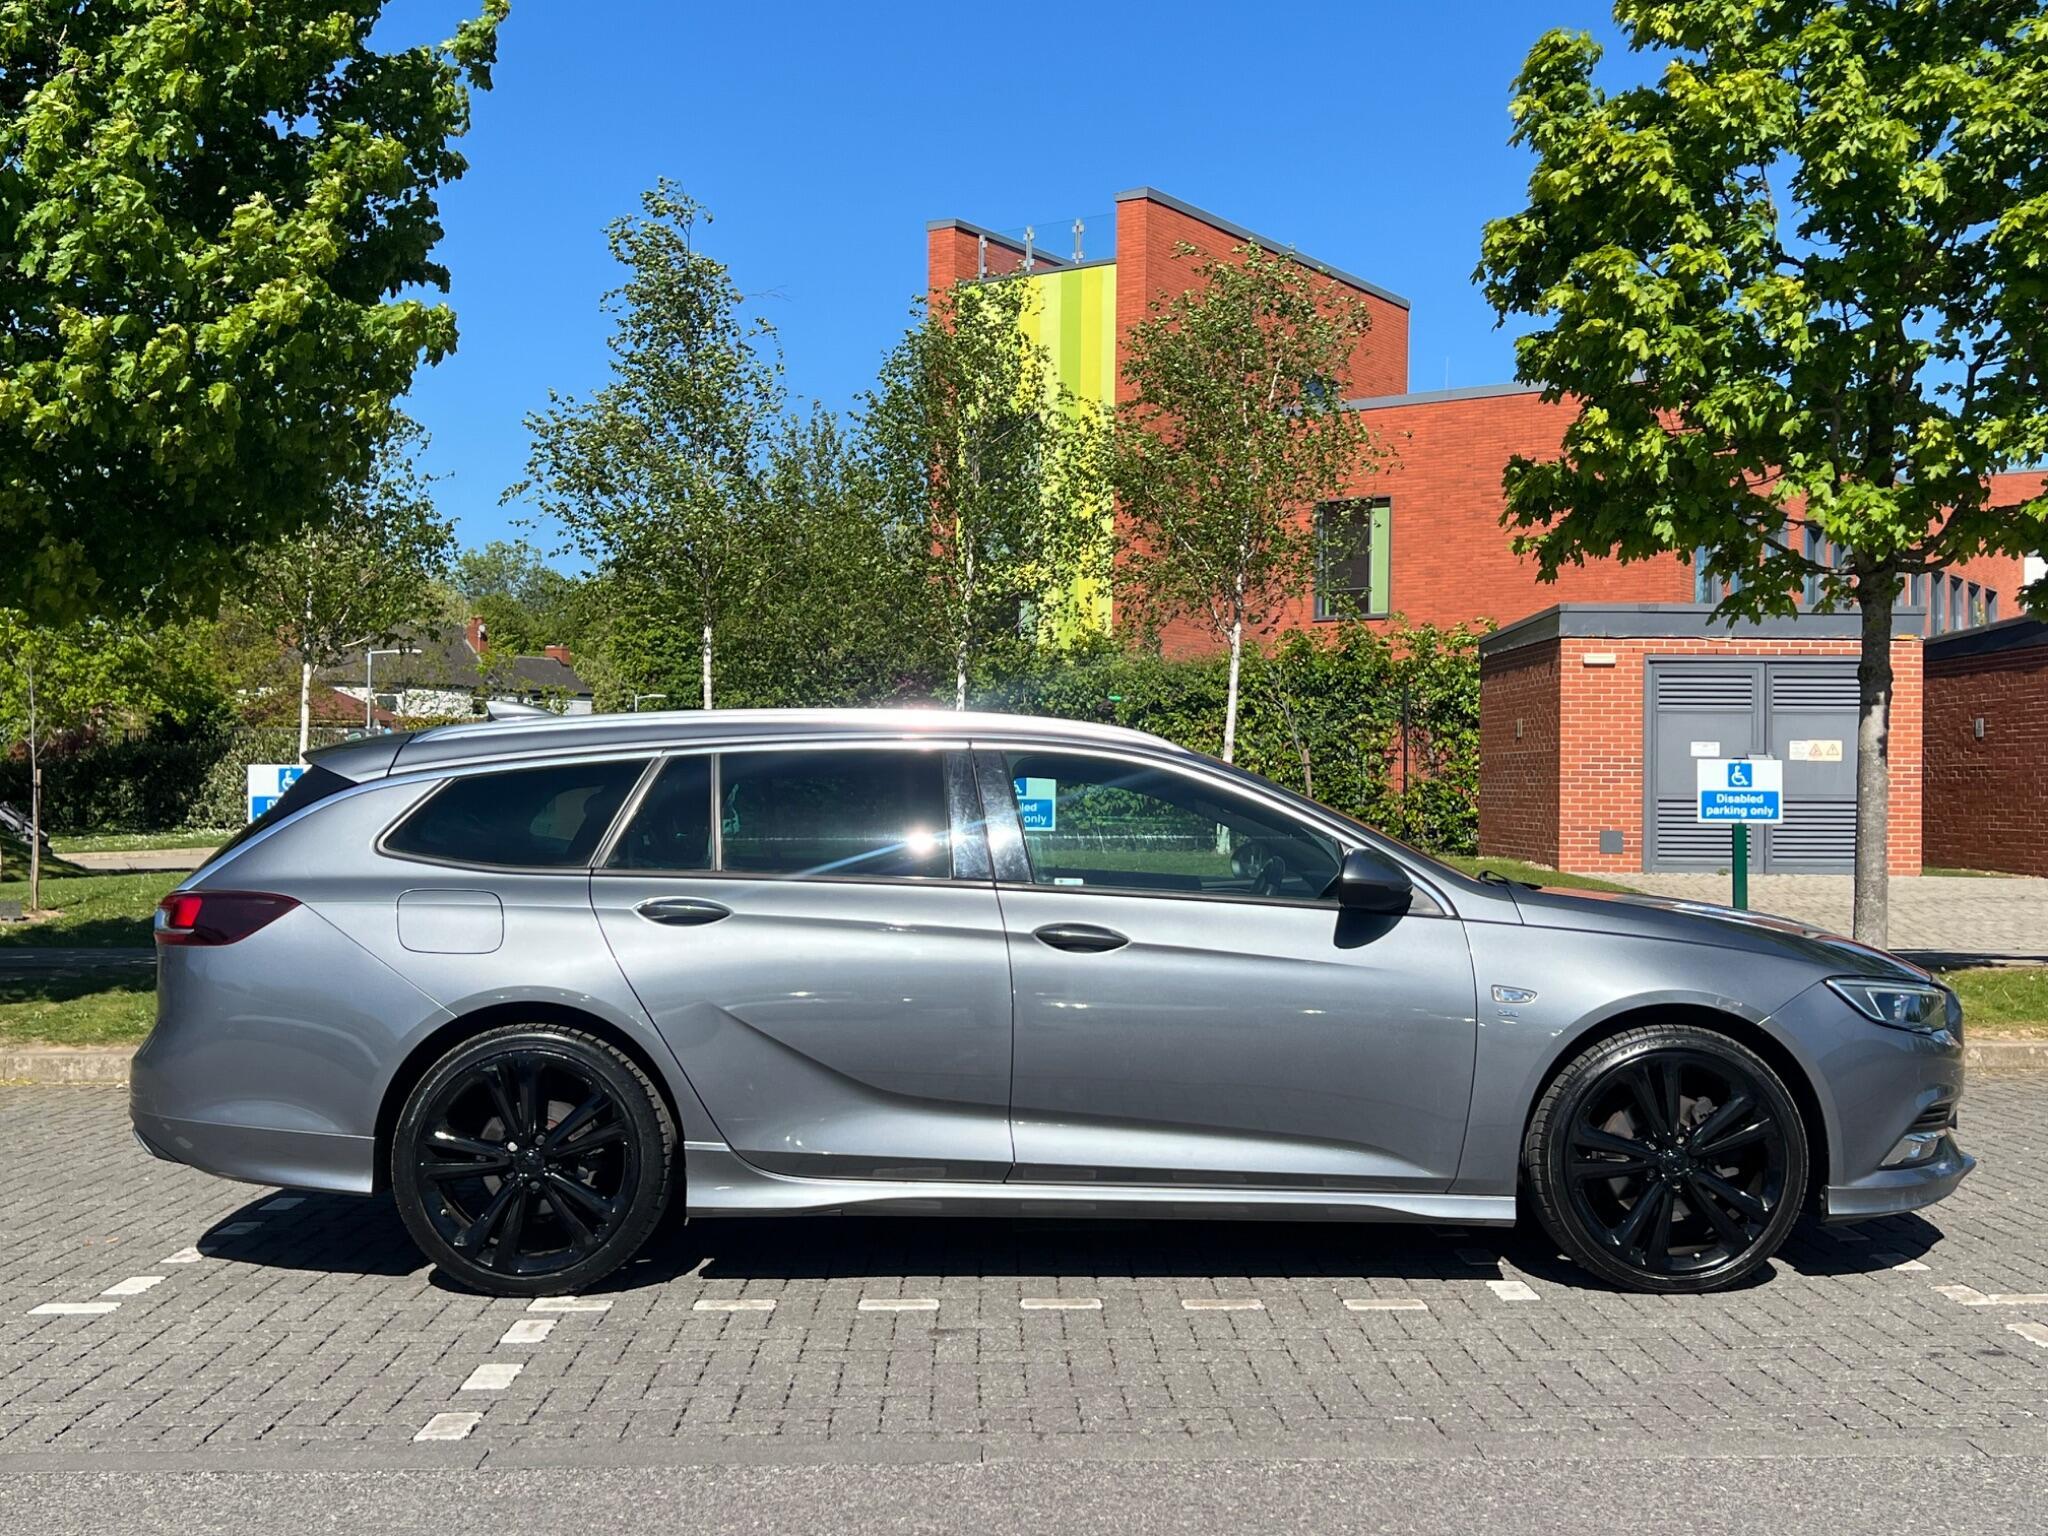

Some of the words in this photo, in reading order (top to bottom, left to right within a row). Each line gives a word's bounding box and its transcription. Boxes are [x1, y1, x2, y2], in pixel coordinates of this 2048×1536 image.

[1716, 794, 1764, 803] Disabled
[1021, 802, 1037, 811] led
[1706, 806, 1747, 817] parking
[1750, 806, 1773, 817] only
[1024, 814, 1046, 825] only
